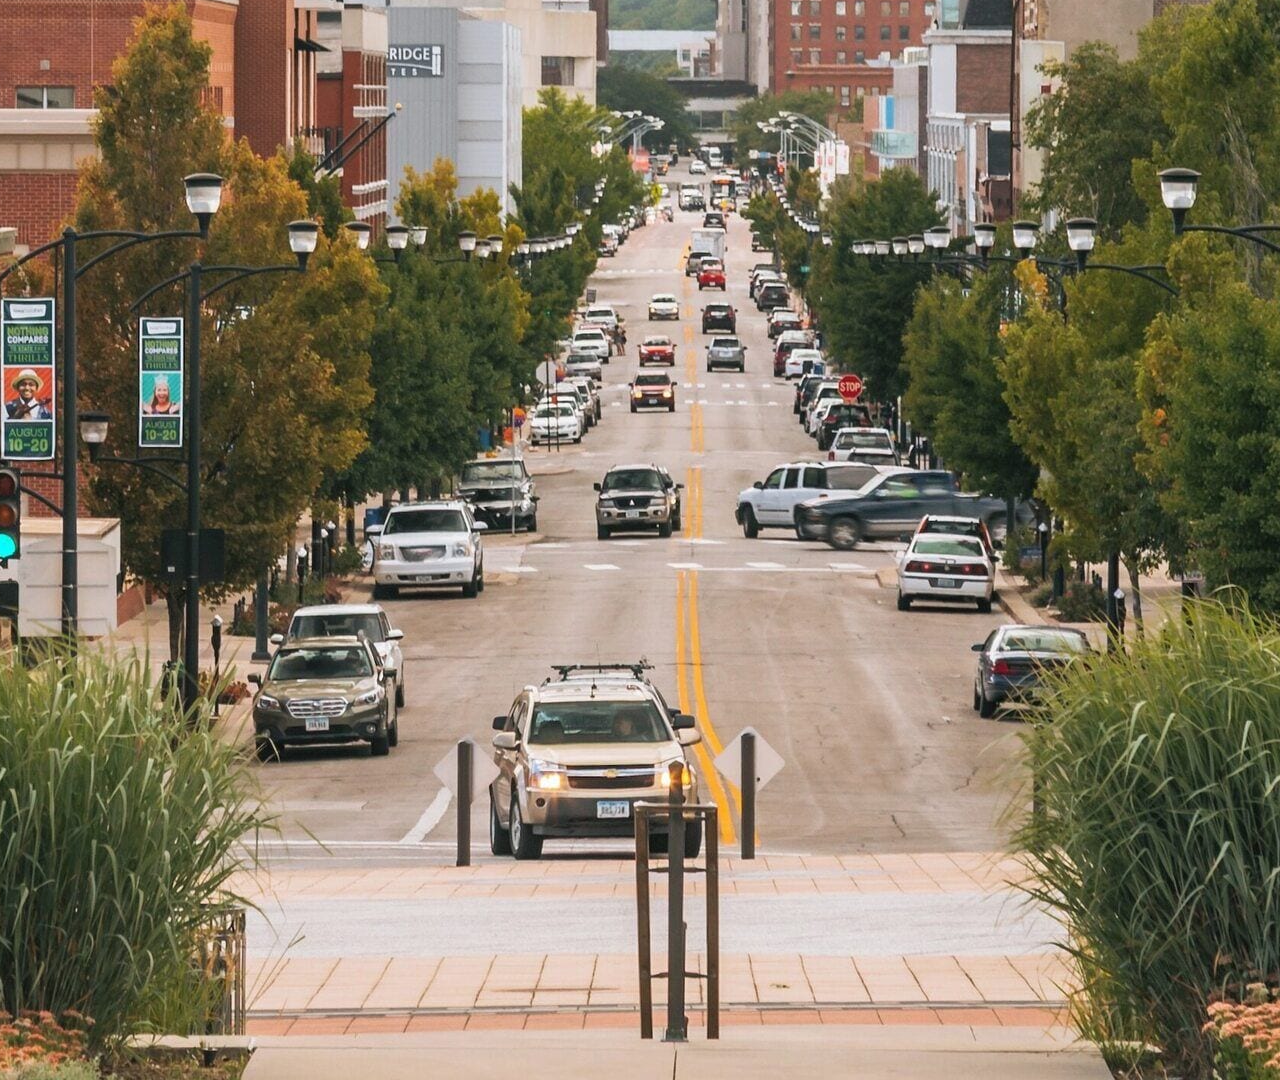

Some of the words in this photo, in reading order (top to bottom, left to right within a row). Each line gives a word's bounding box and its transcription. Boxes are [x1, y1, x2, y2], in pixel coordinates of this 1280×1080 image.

[7, 326, 49, 335] NOTHING
[7, 335, 49, 344] COMPARES
[144, 340, 179, 348] NOTHING
[8, 353, 49, 362] THRILLS
[839, 382, 861, 391] STOP
[144, 421, 177, 429] AUGUST
[8, 428, 48, 437] AUGUST
[144, 429, 177, 440] 10-20
[8, 438, 48, 452] 10-20
